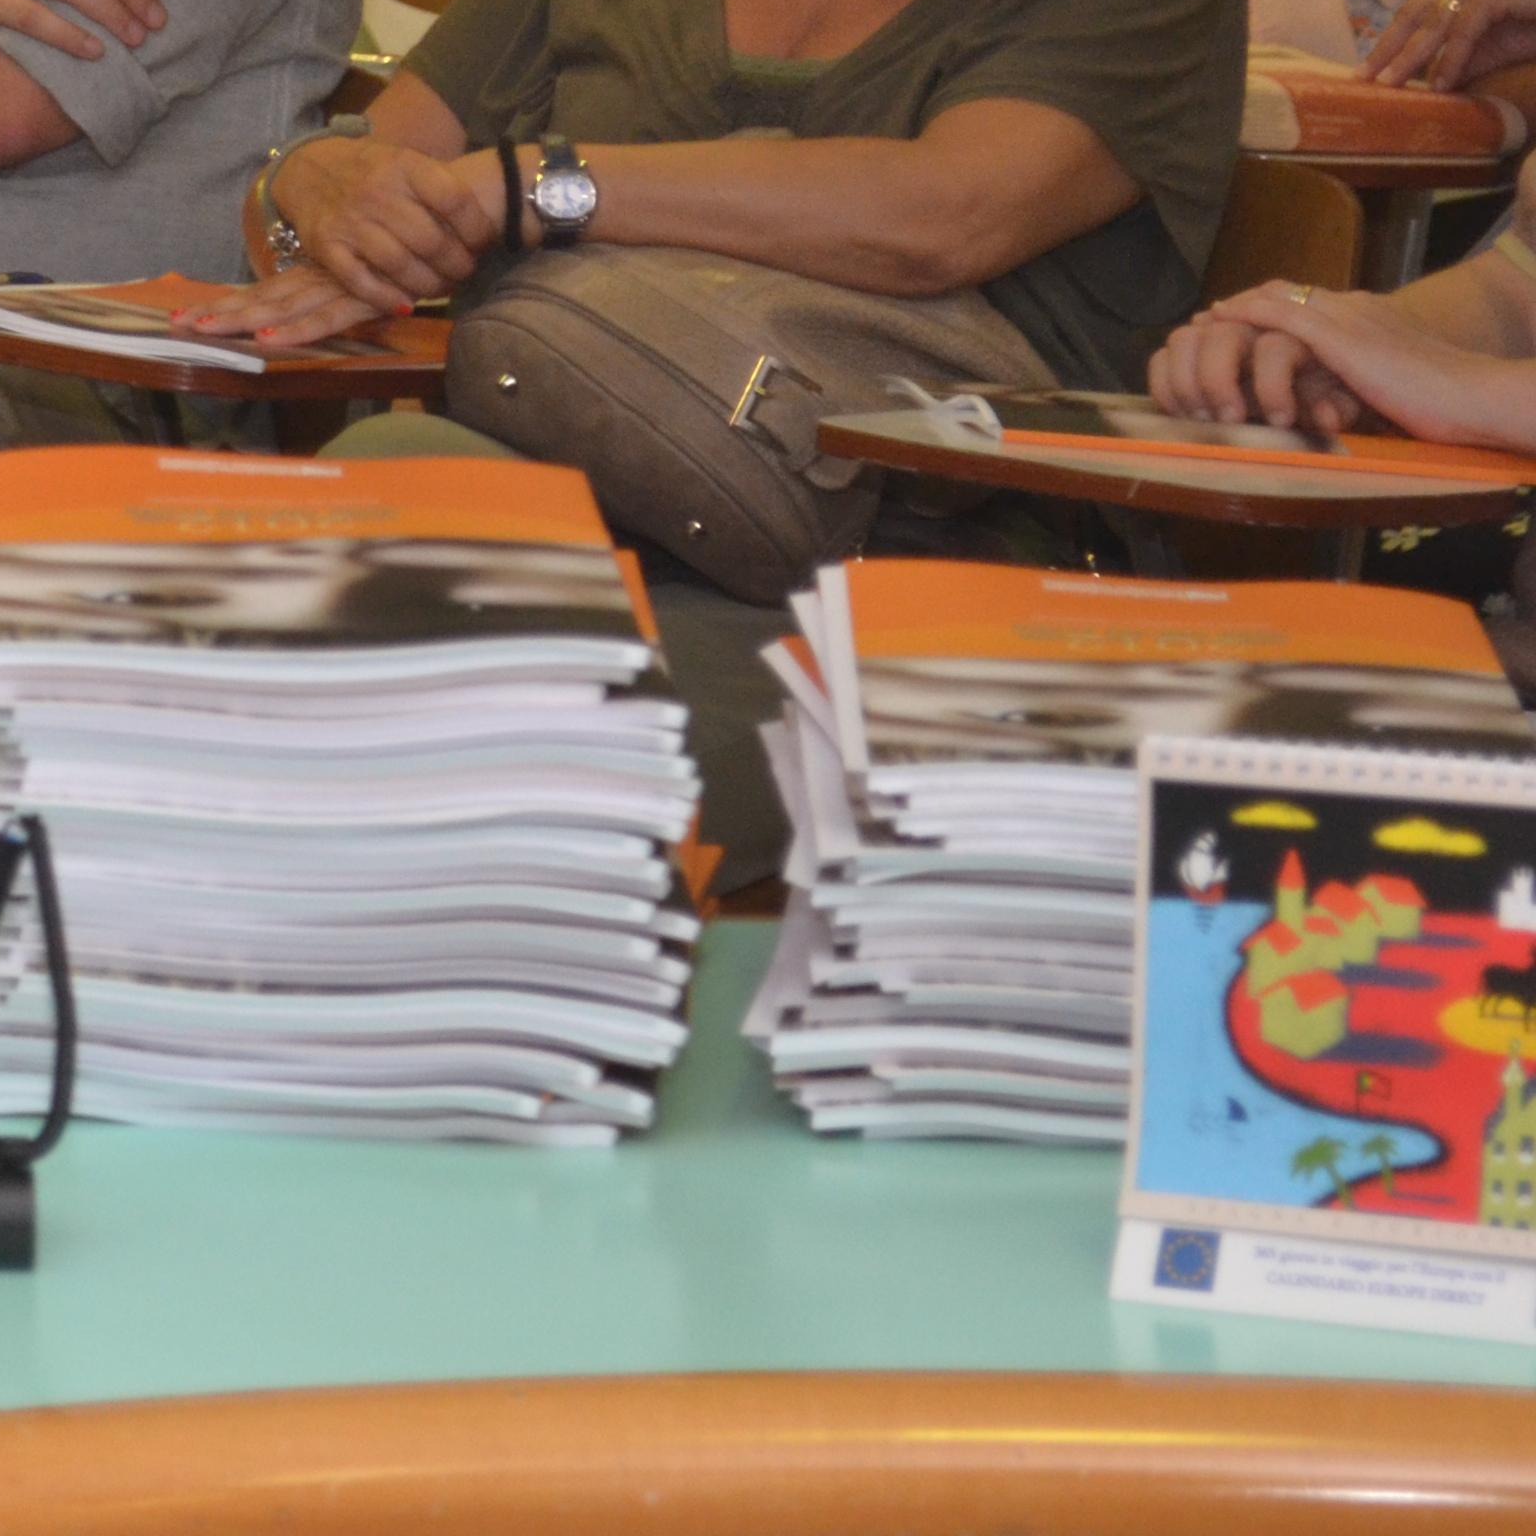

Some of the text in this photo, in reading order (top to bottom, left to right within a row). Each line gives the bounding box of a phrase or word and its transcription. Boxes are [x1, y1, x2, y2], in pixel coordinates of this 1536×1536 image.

[1340, 1253, 1380, 1272] viaggio
[1266, 1269, 1487, 1307] CALENDARIO EUROPE DIRECT
